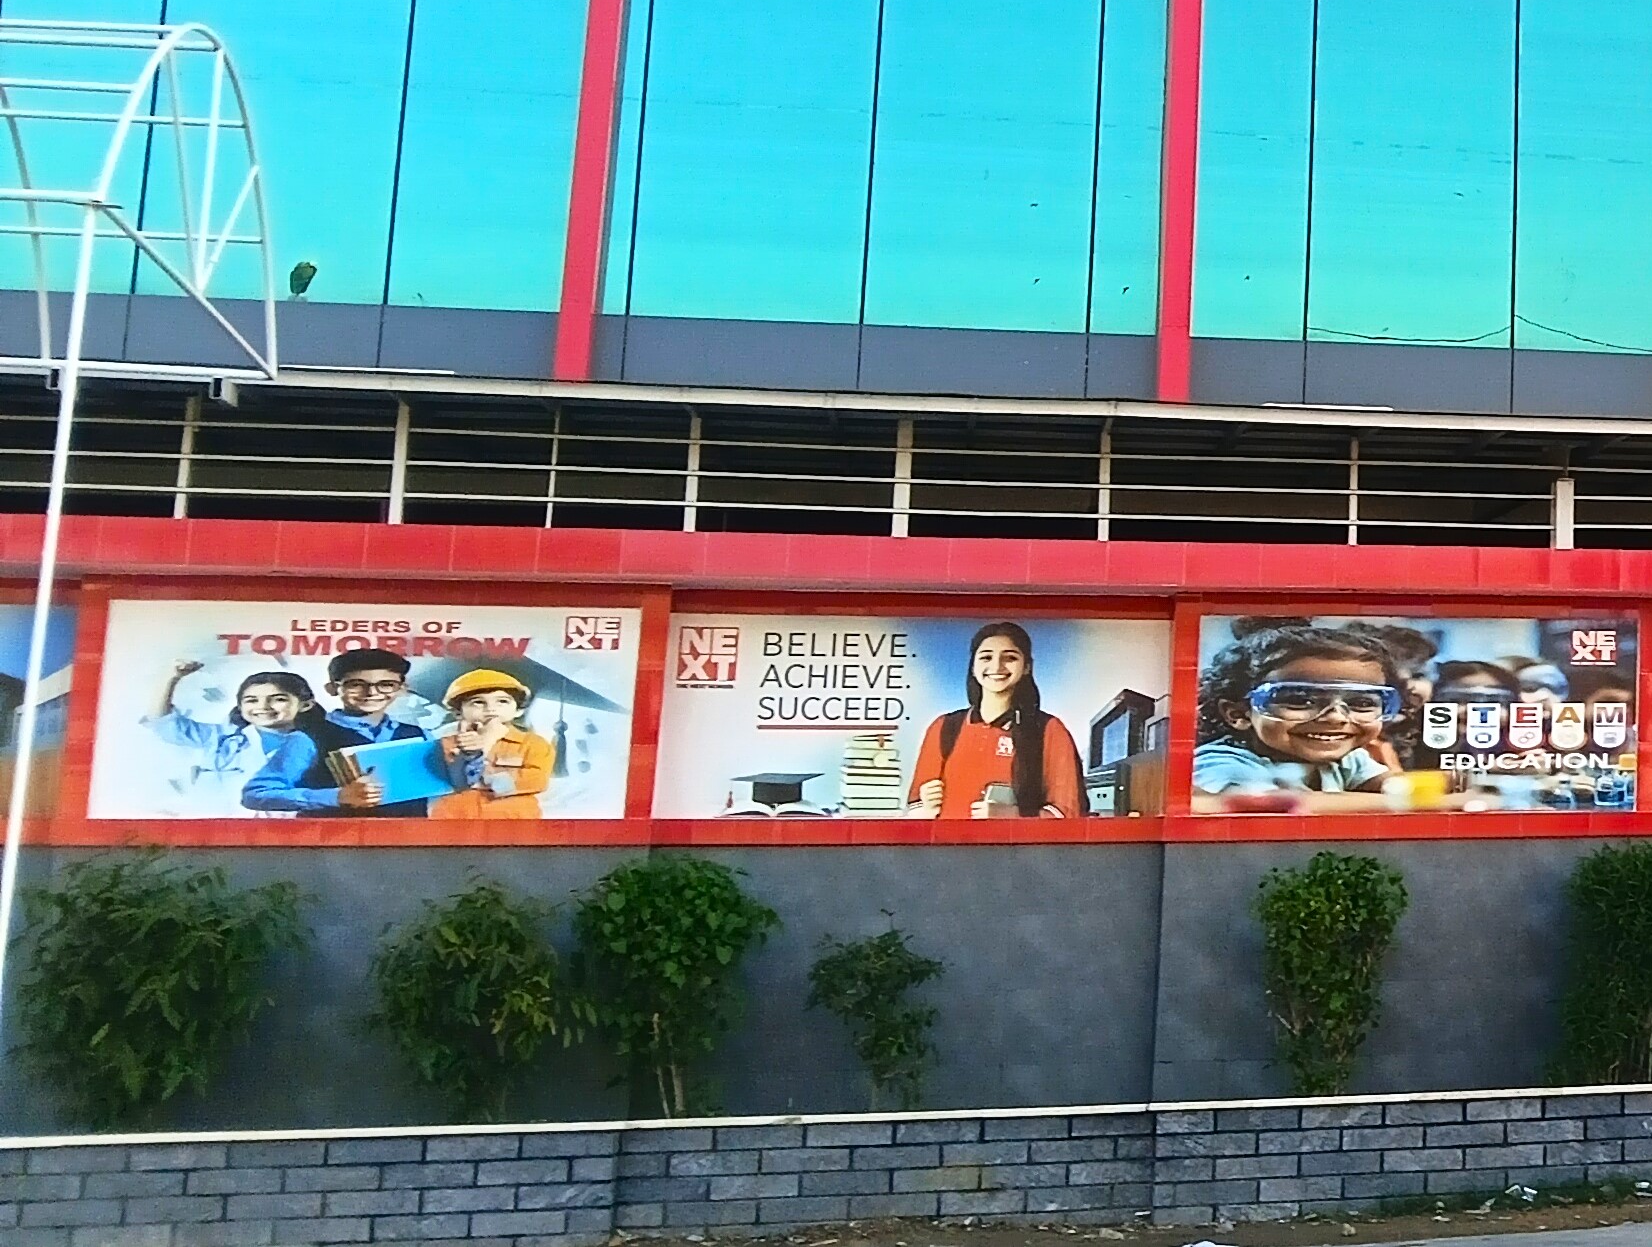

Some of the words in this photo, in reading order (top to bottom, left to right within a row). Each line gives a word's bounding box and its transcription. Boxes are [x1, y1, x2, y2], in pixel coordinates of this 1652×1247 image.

[291, 619, 411, 634] LEDERS
[422, 621, 462, 634] OF
[217, 634, 531, 661] TOMORROW
[763, 632, 917, 658] BELIEVE.
[759, 663, 911, 689] ACHIEVE.
[757, 696, 911, 721] SUCCEED.
[1428, 706, 1624, 725] STEAM
[1440, 753, 1609, 770] EDUCATION
